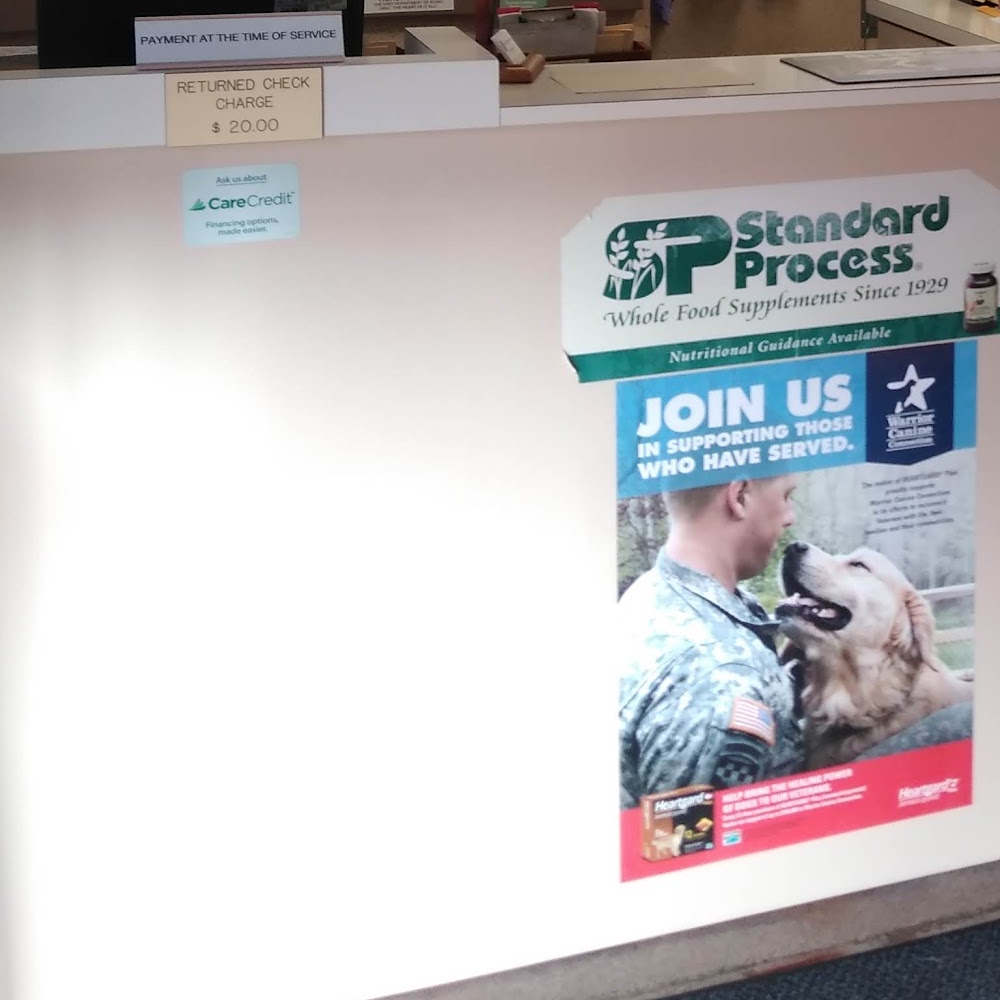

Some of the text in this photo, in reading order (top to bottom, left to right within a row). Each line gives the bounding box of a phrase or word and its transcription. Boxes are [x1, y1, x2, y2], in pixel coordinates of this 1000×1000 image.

[140, 29, 337, 45] PAYMENT AT THE TIME OF SERVICE
[176, 76, 311, 94] RETURNED CHECK
[215, 95, 274, 110] CHARGE
[211, 118, 279, 134] $ 20.00
[216, 176, 231, 184] Ask
[243, 174, 268, 182] about
[208, 192, 293, 210] CareCredit
[205, 219, 246, 229] Financing
[735, 195, 950, 249] Standard
[218, 228, 241, 236] made
[734, 243, 914, 289] Process
[603, 277, 949, 328] Whole Food Supplements Since 1929
[668, 326, 892, 364] Nutritional Guidance Available
[636, 374, 853, 438] JOIN US
[637, 416, 853, 458] IN SUPPORTING THOSE
[887, 425, 934, 439] Canine
[636, 435, 855, 480] WHO HAVE SERVED.
